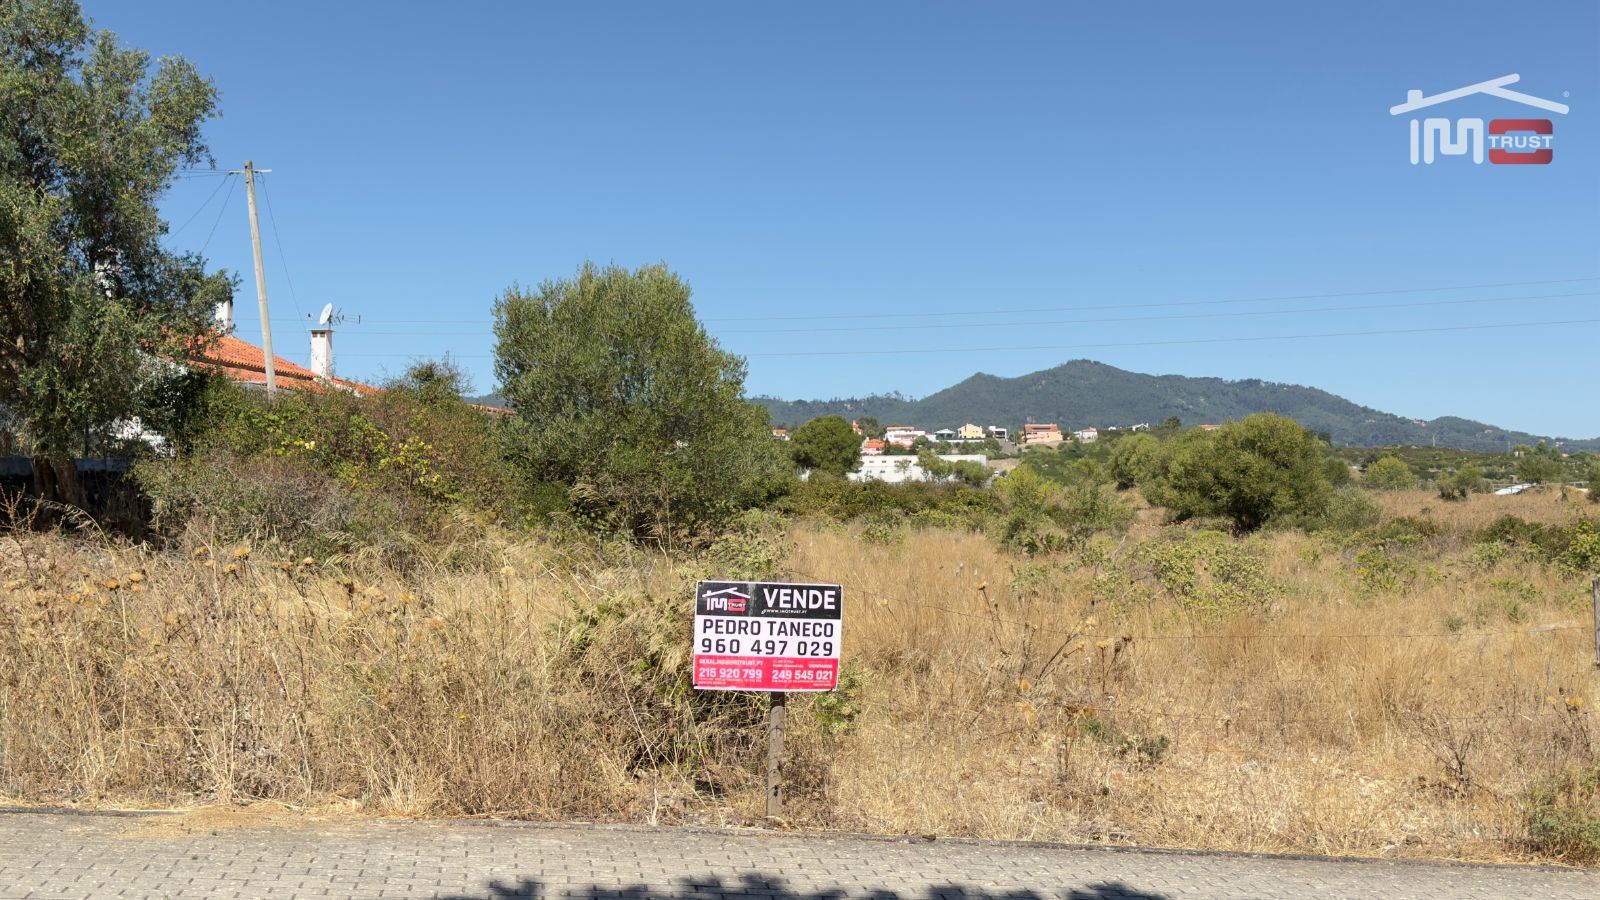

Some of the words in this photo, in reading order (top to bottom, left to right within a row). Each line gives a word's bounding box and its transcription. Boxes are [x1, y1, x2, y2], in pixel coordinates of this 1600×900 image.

[763, 588, 836, 609] VENDE
[702, 619, 761, 636] PEDRO
[767, 621, 834, 638] TANECO
[702, 638, 740, 654] 960
[751, 639, 788, 656] 497
[797, 641, 833, 657] 029
[699, 667, 717, 678] 215
[719, 668, 740, 679] 920
[742, 668, 763, 679] 799
[772, 669, 792, 680] 249
[794, 670, 814, 681] 545
[816, 670, 833, 681] 021
